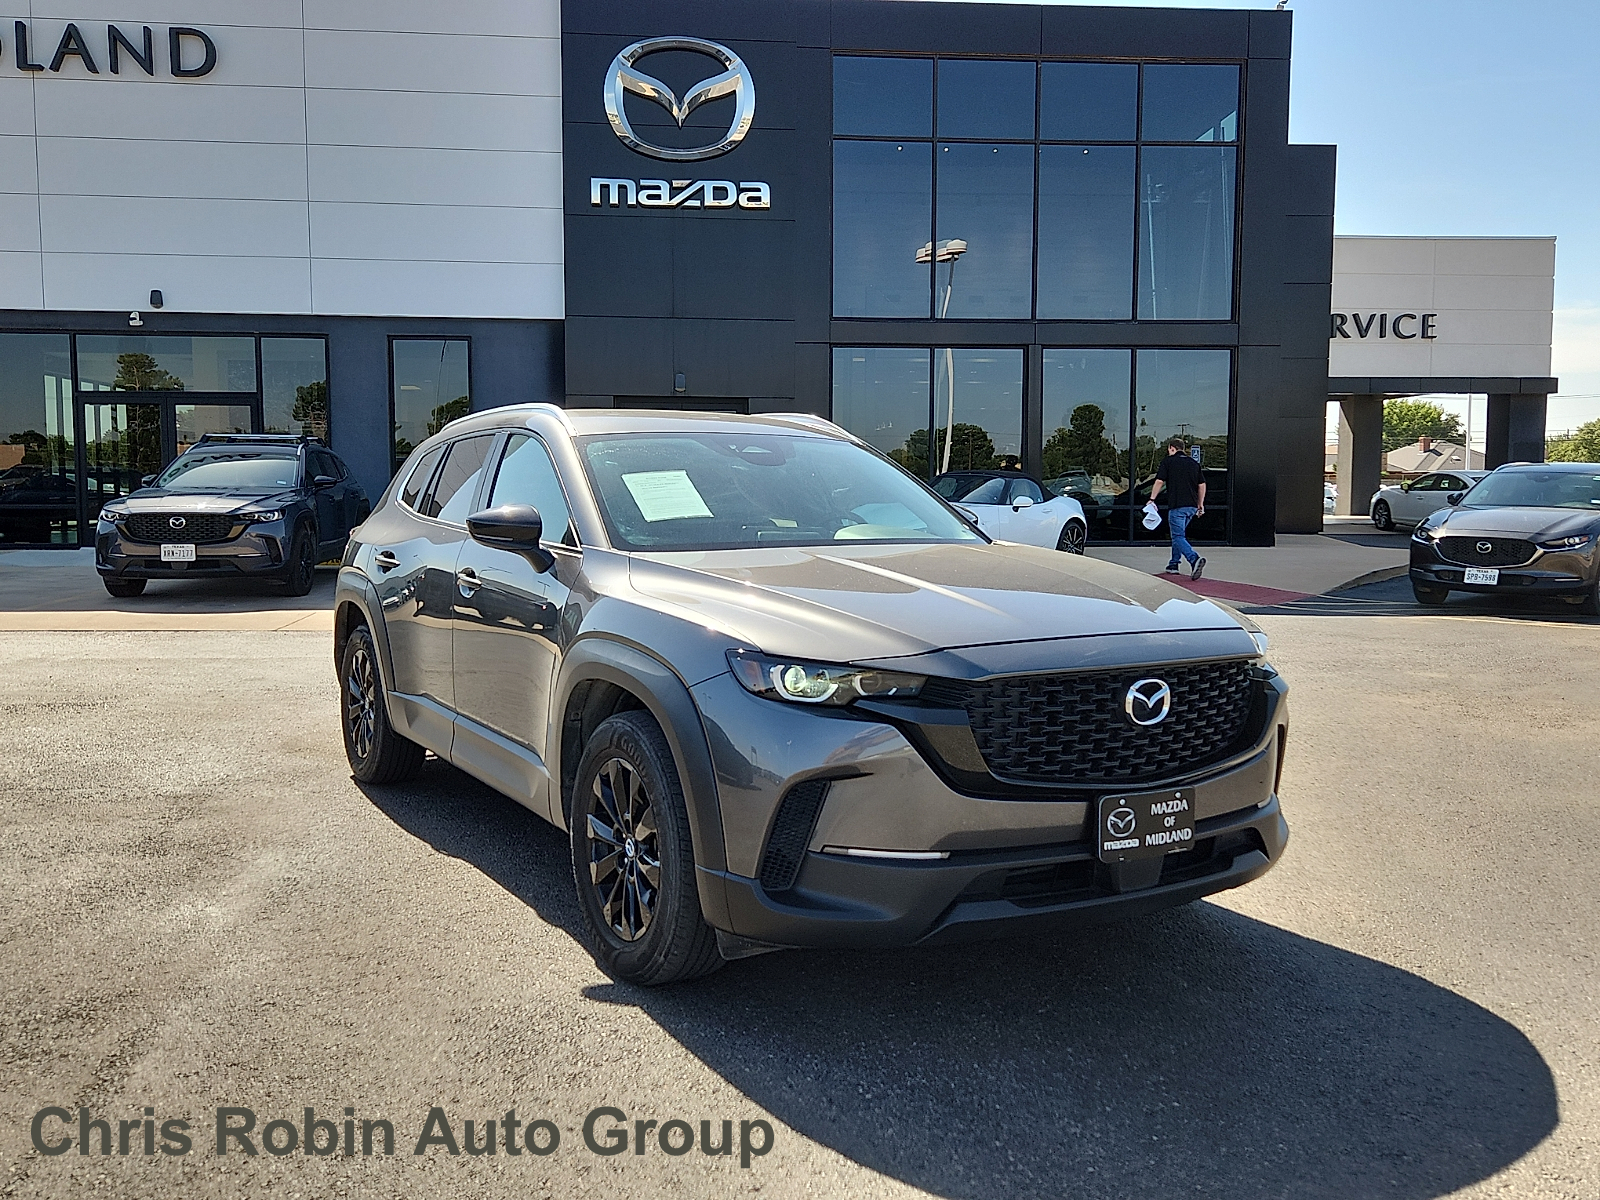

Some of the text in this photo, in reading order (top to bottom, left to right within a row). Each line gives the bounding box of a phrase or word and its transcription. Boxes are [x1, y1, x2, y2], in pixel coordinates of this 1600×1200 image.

[0, 20, 217, 78] LAND
[1150, 799, 1189, 816] MAZDA
[1163, 815, 1176, 828] OF
[1145, 828, 1193, 847] MIDLAND
